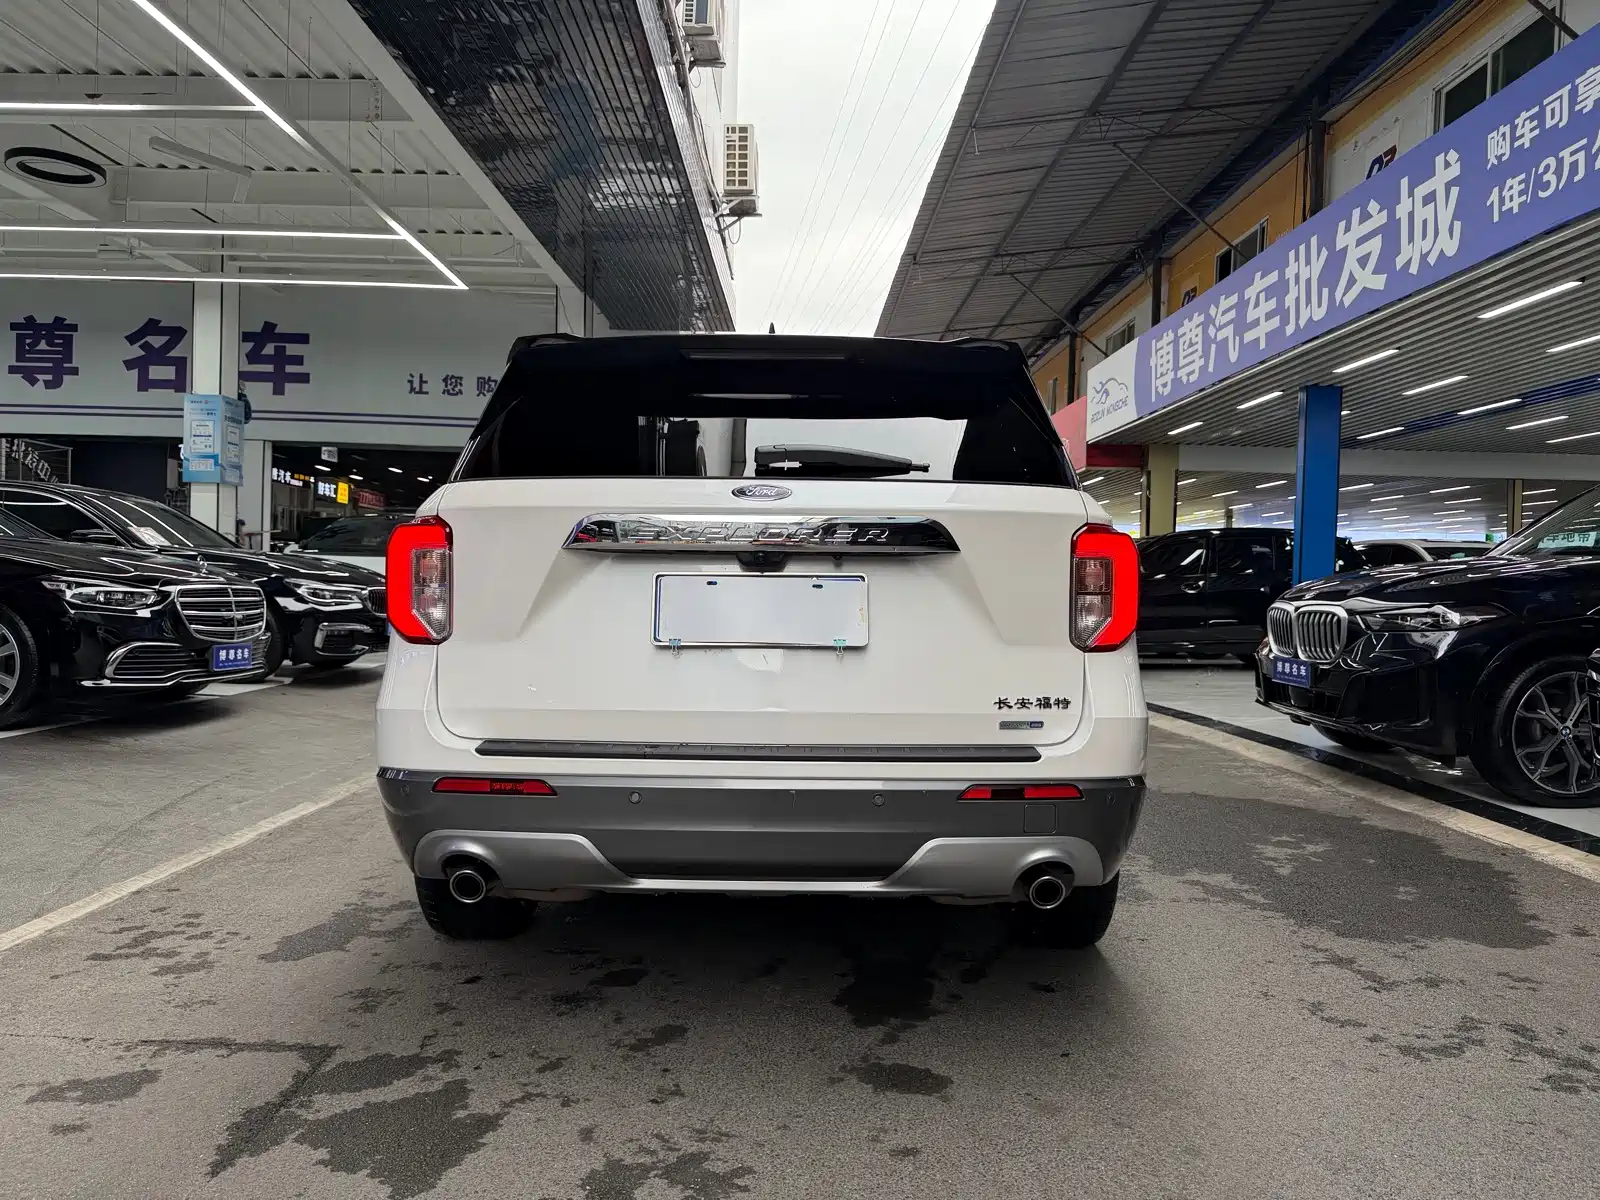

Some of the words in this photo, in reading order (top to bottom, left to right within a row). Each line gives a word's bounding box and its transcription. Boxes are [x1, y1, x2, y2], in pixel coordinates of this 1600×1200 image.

[1486, 64, 1600, 170] 购车可享
[1150, 148, 1462, 402] 博尊汽车批发城
[8, 315, 311, 396] 尊名车
[407, 373, 498, 397] 让您购
[745, 485, 778, 496] Ford
[627, 524, 889, 542] EXPLORER
[993, 696, 1071, 710] 长安福特
